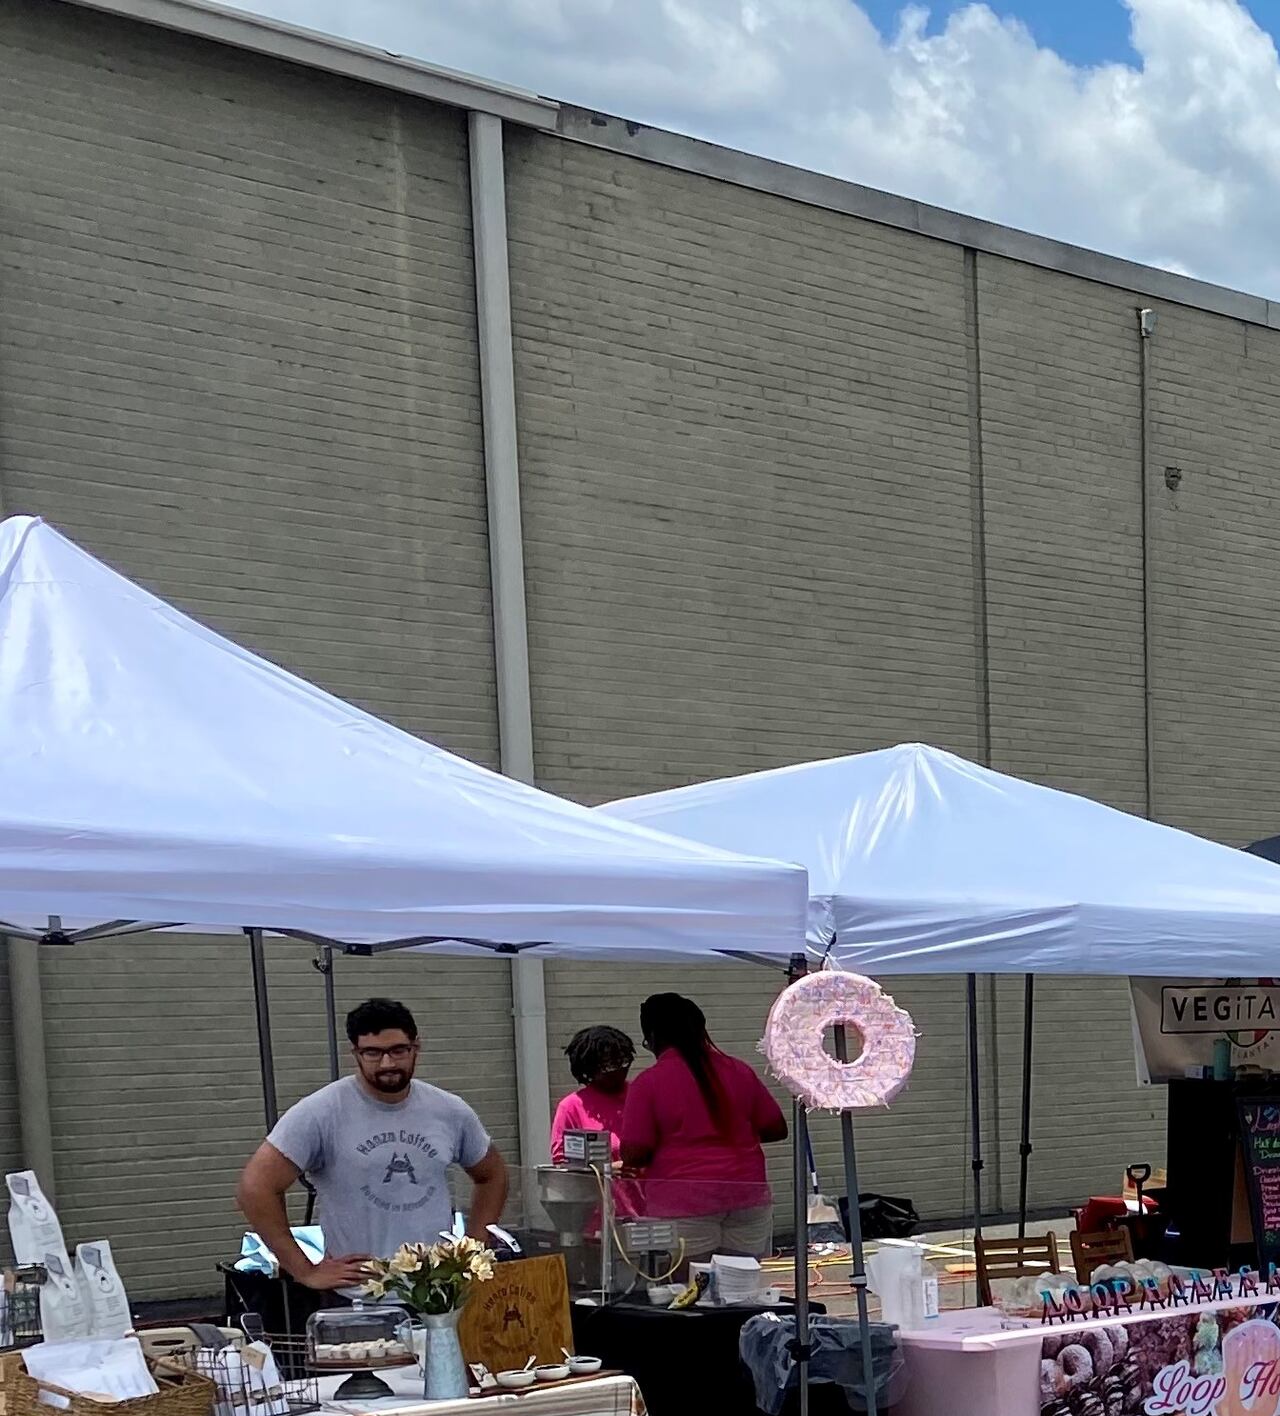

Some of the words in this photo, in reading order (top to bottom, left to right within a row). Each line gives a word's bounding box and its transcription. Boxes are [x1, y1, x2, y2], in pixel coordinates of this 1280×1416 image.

[1231, 1040, 1270, 1060] TLANTA
[400, 1129, 438, 1158] Coffee
[1149, 1364, 1227, 1414] Loop
